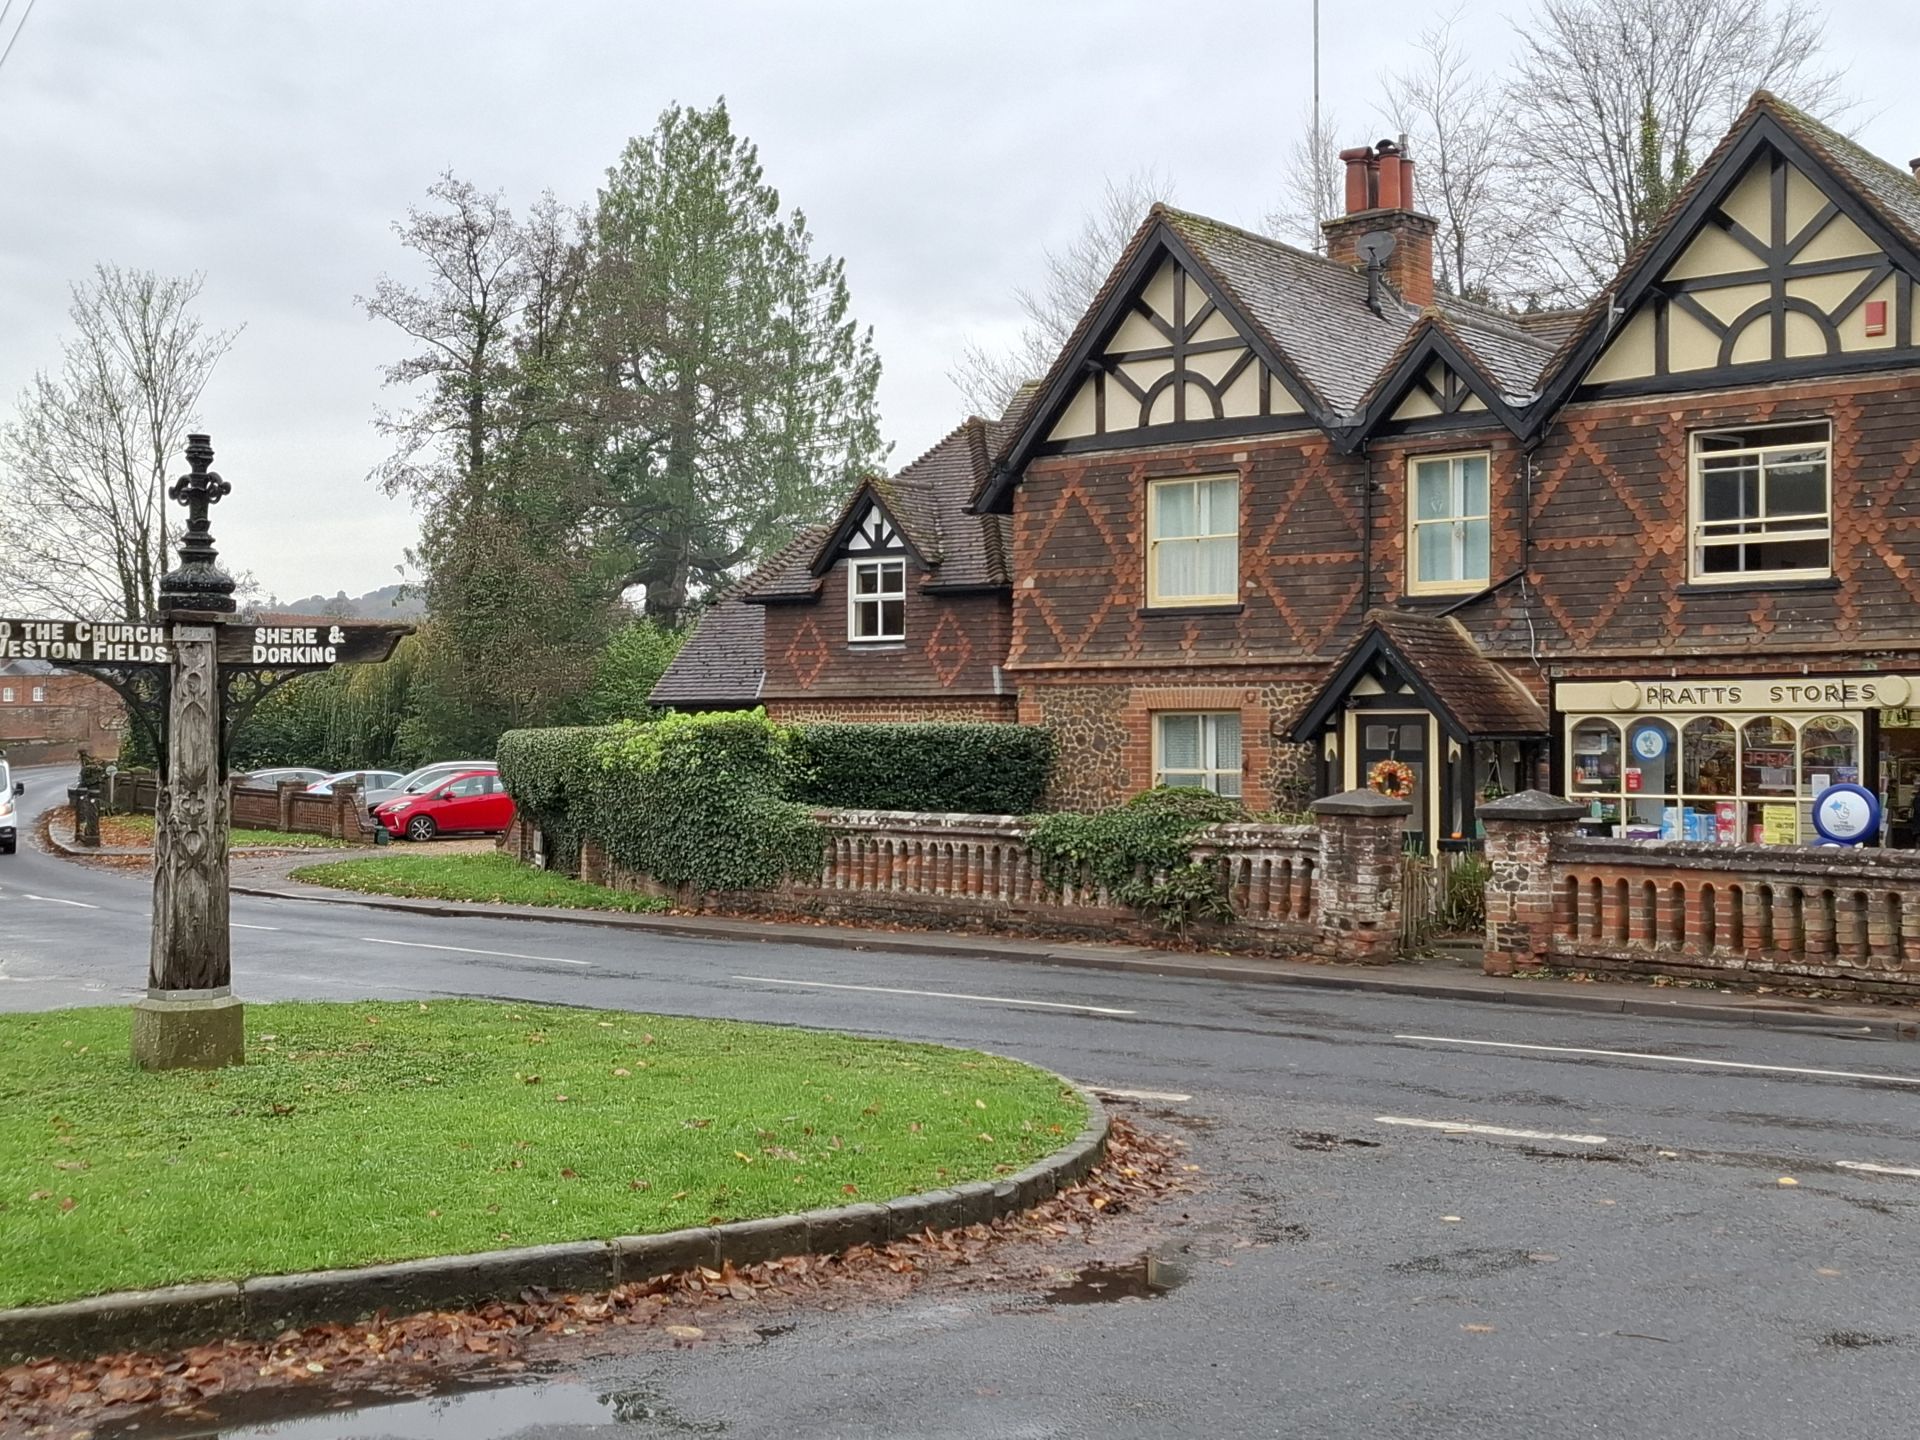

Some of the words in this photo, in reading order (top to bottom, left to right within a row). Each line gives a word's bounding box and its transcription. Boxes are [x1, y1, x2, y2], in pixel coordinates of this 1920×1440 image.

[21, 623, 64, 640] THE
[75, 622, 163, 643] CHURCH
[255, 627, 317, 644] SHERE
[328, 625, 346, 643] &
[93, 641, 168, 662] FIELDS
[253, 645, 336, 663] DORKING
[1646, 686, 1742, 704] PRATTS
[1770, 684, 1877, 704] STORES
[1388, 728, 1398, 745] 7
